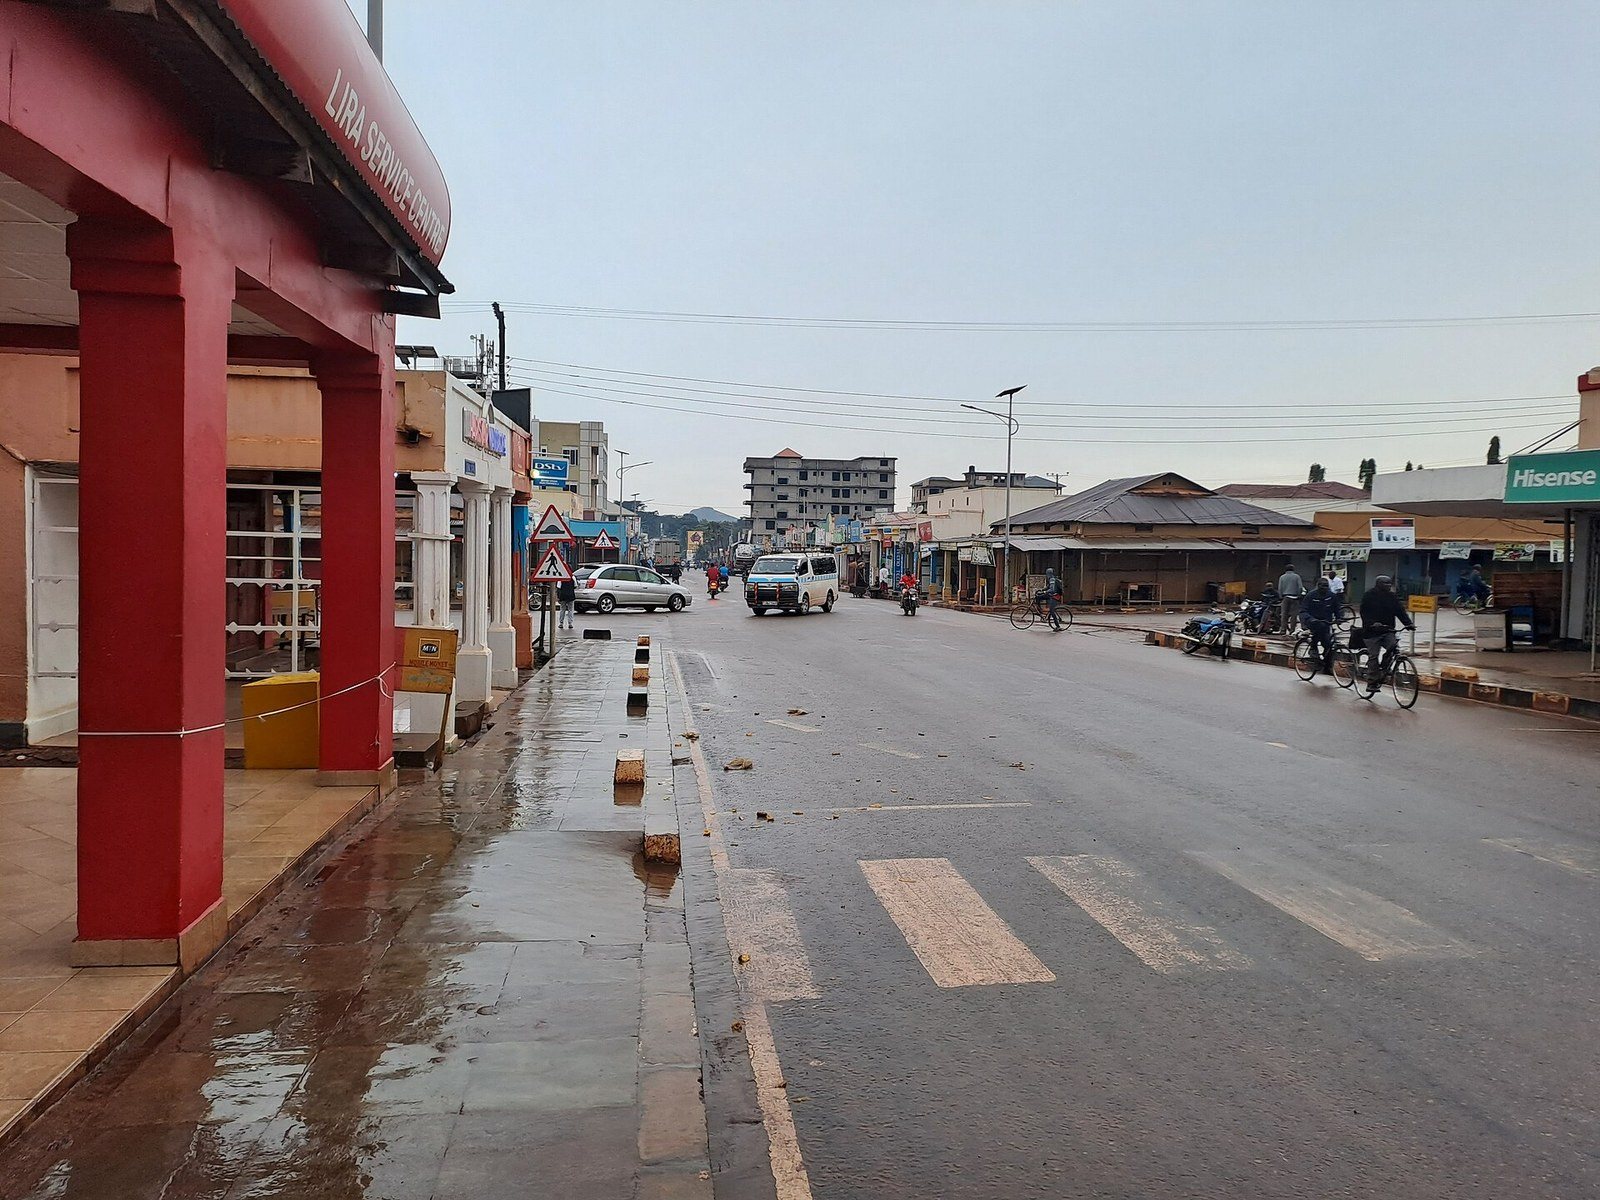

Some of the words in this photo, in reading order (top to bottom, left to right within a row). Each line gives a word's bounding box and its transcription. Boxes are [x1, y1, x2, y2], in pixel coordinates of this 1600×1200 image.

[324, 68, 366, 148] LIRA
[361, 120, 415, 211] SERVICE
[407, 188, 446, 255] CENTRE
[1512, 469, 1597, 488] Hisense
